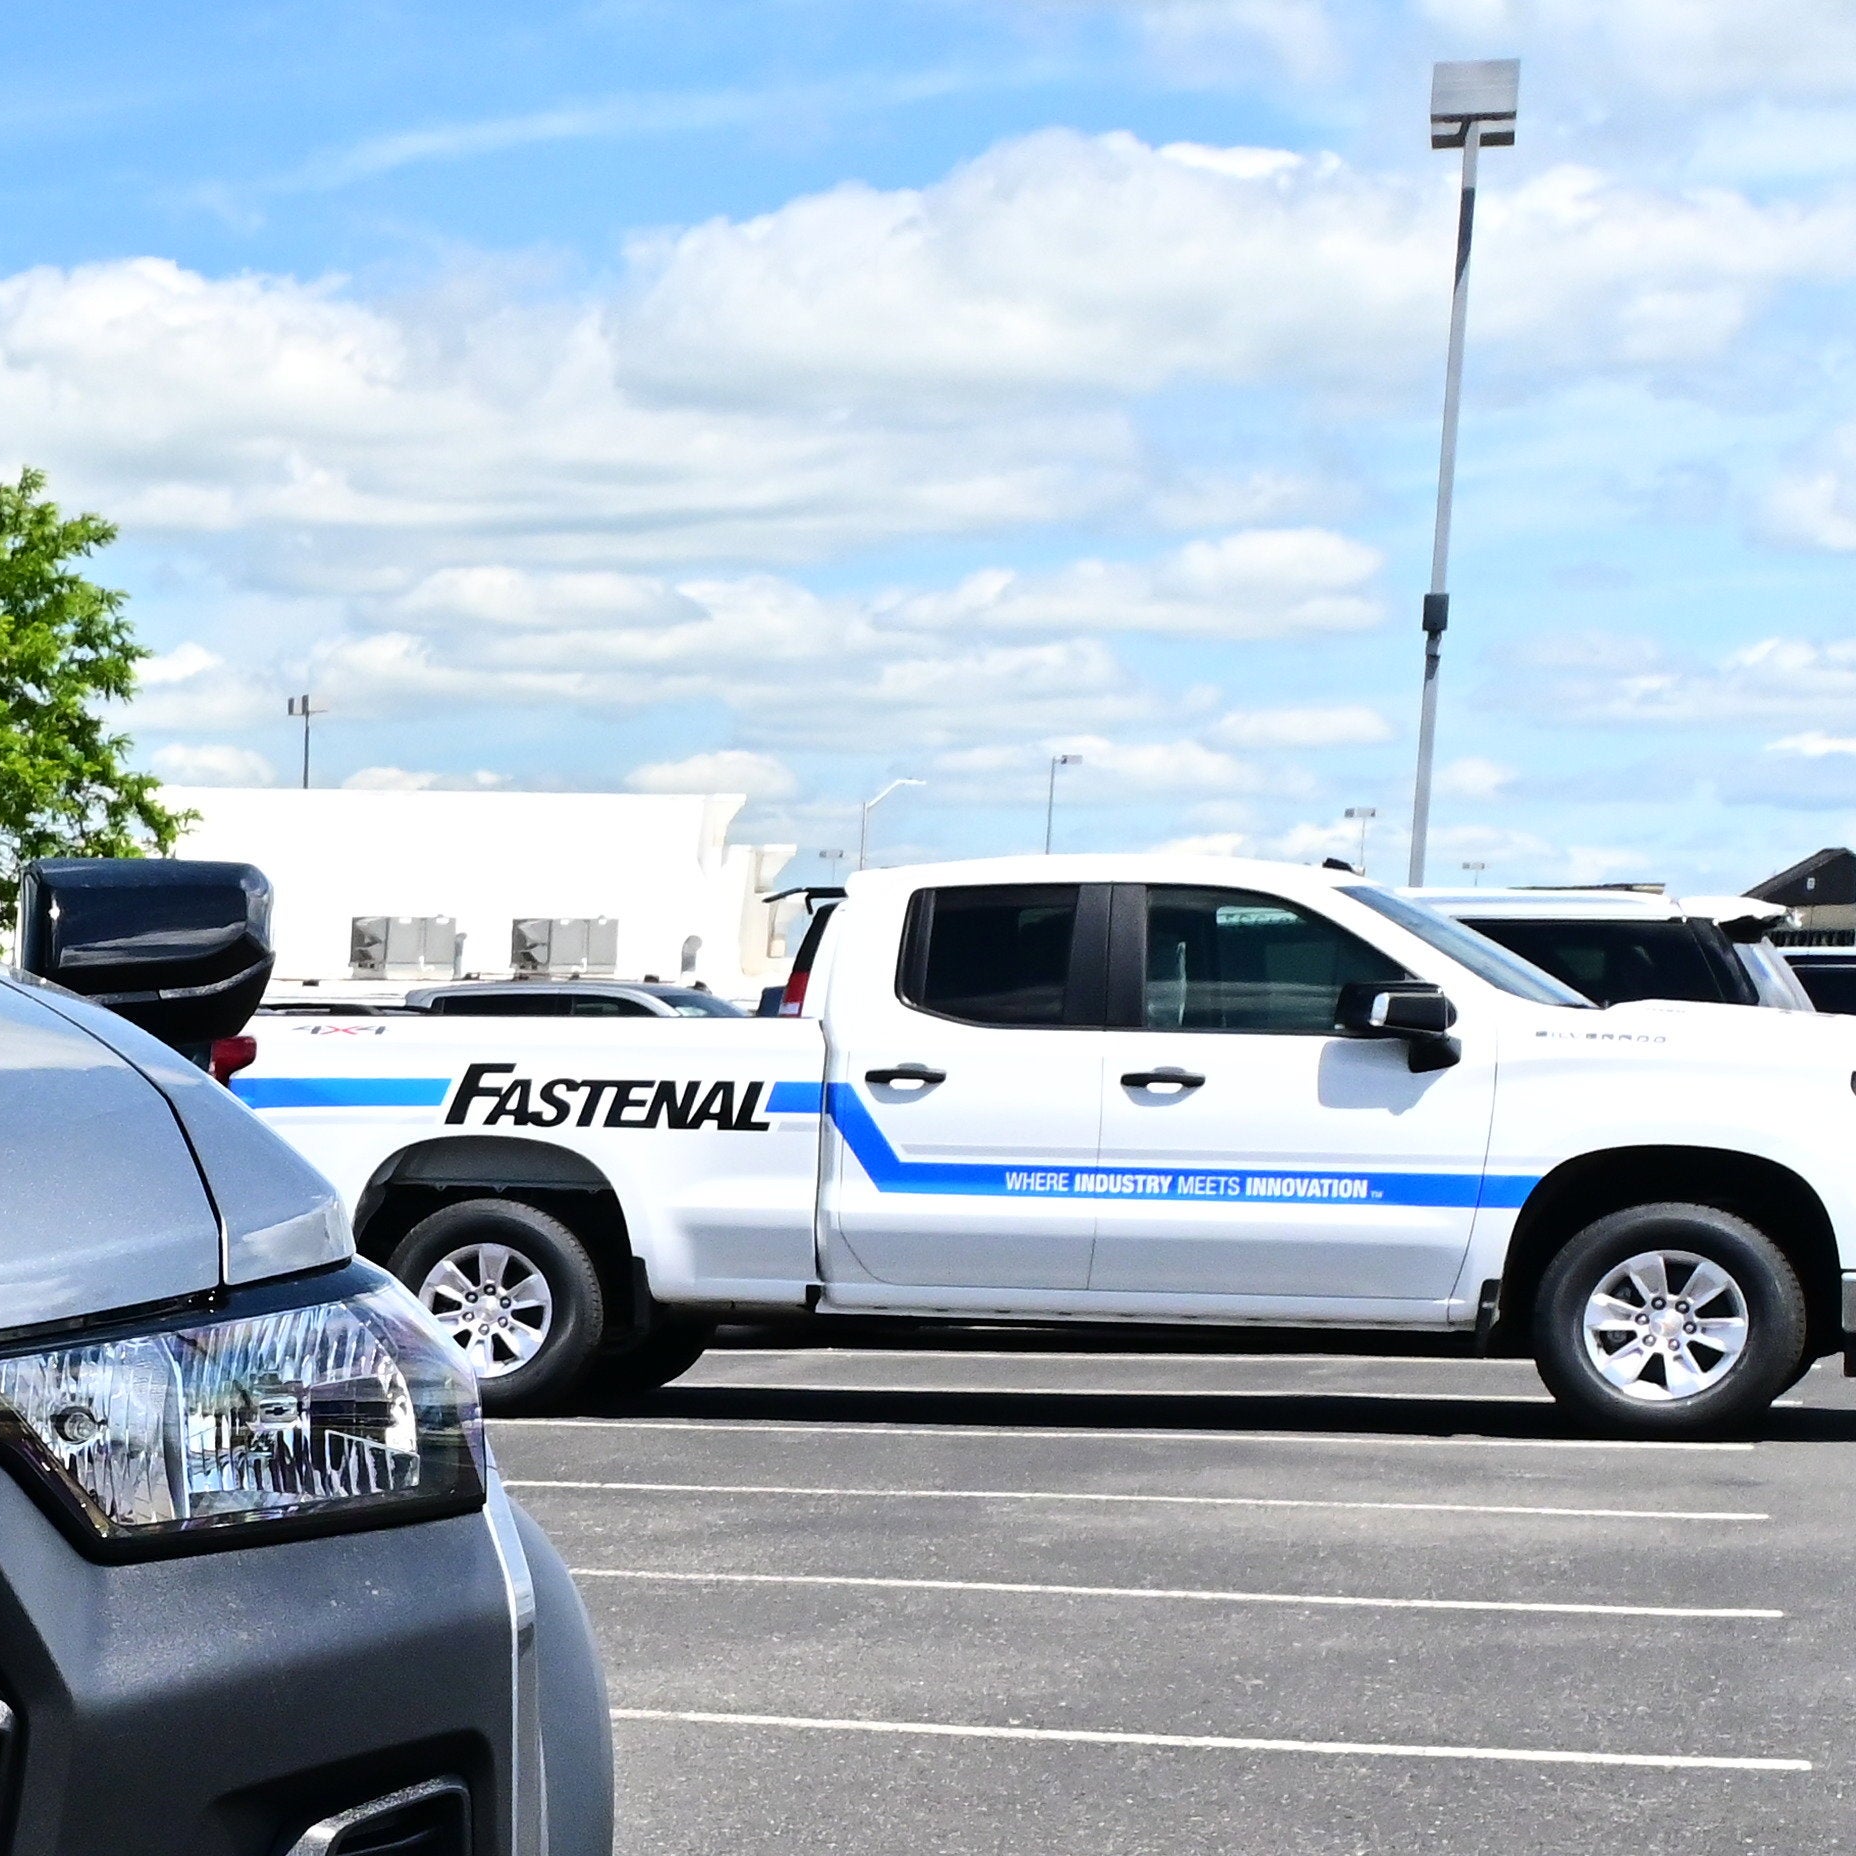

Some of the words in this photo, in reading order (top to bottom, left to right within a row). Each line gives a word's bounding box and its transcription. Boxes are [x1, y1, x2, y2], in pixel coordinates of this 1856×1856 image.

[445, 1063, 770, 1131] FASTENAL
[1006, 1171, 1069, 1191] WHERE
[1074, 1173, 1173, 1194] INDUSTRY
[1177, 1175, 1240, 1196] MEETS
[1246, 1177, 1368, 1198] INNOVATION
